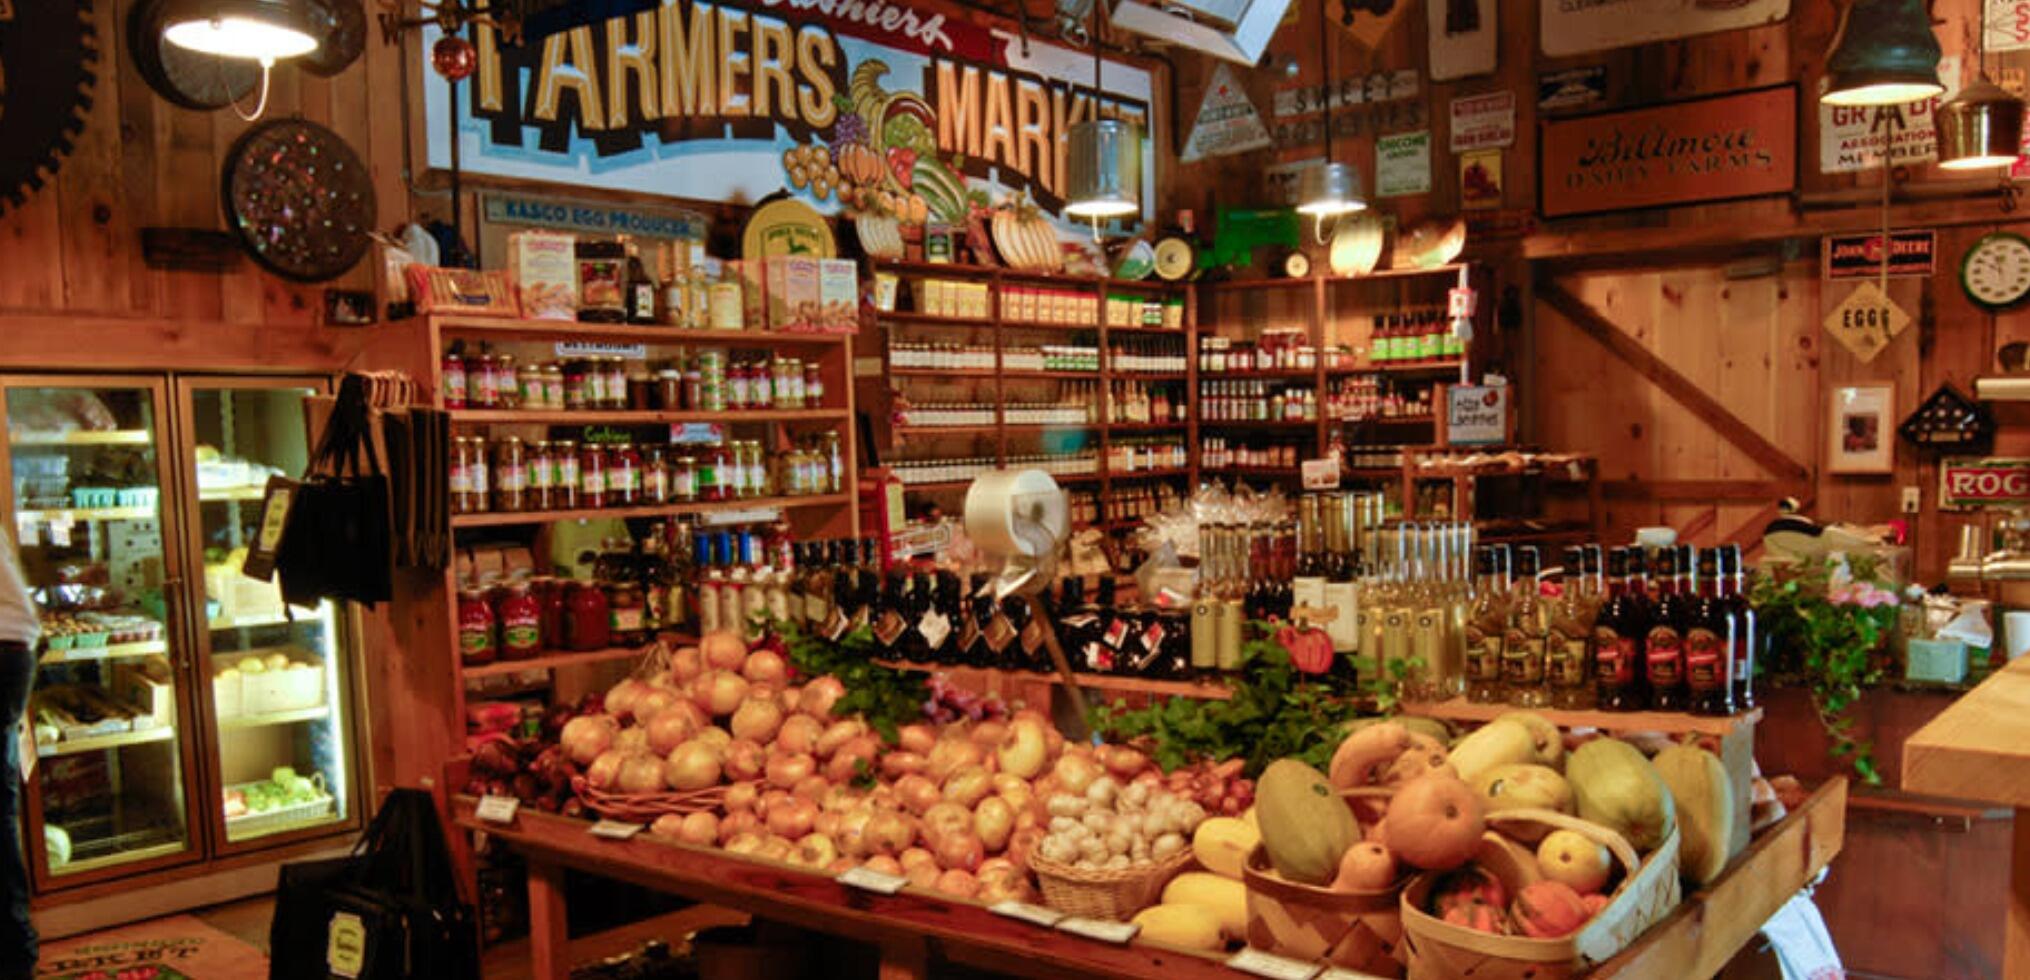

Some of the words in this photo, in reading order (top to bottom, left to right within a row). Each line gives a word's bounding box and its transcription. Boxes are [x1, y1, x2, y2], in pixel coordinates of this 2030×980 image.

[936, 58, 1145, 199] MARK
[506, 200, 568, 221] KASCO
[572, 208, 605, 226] EGG
[608, 211, 690, 235] PRODUCER
